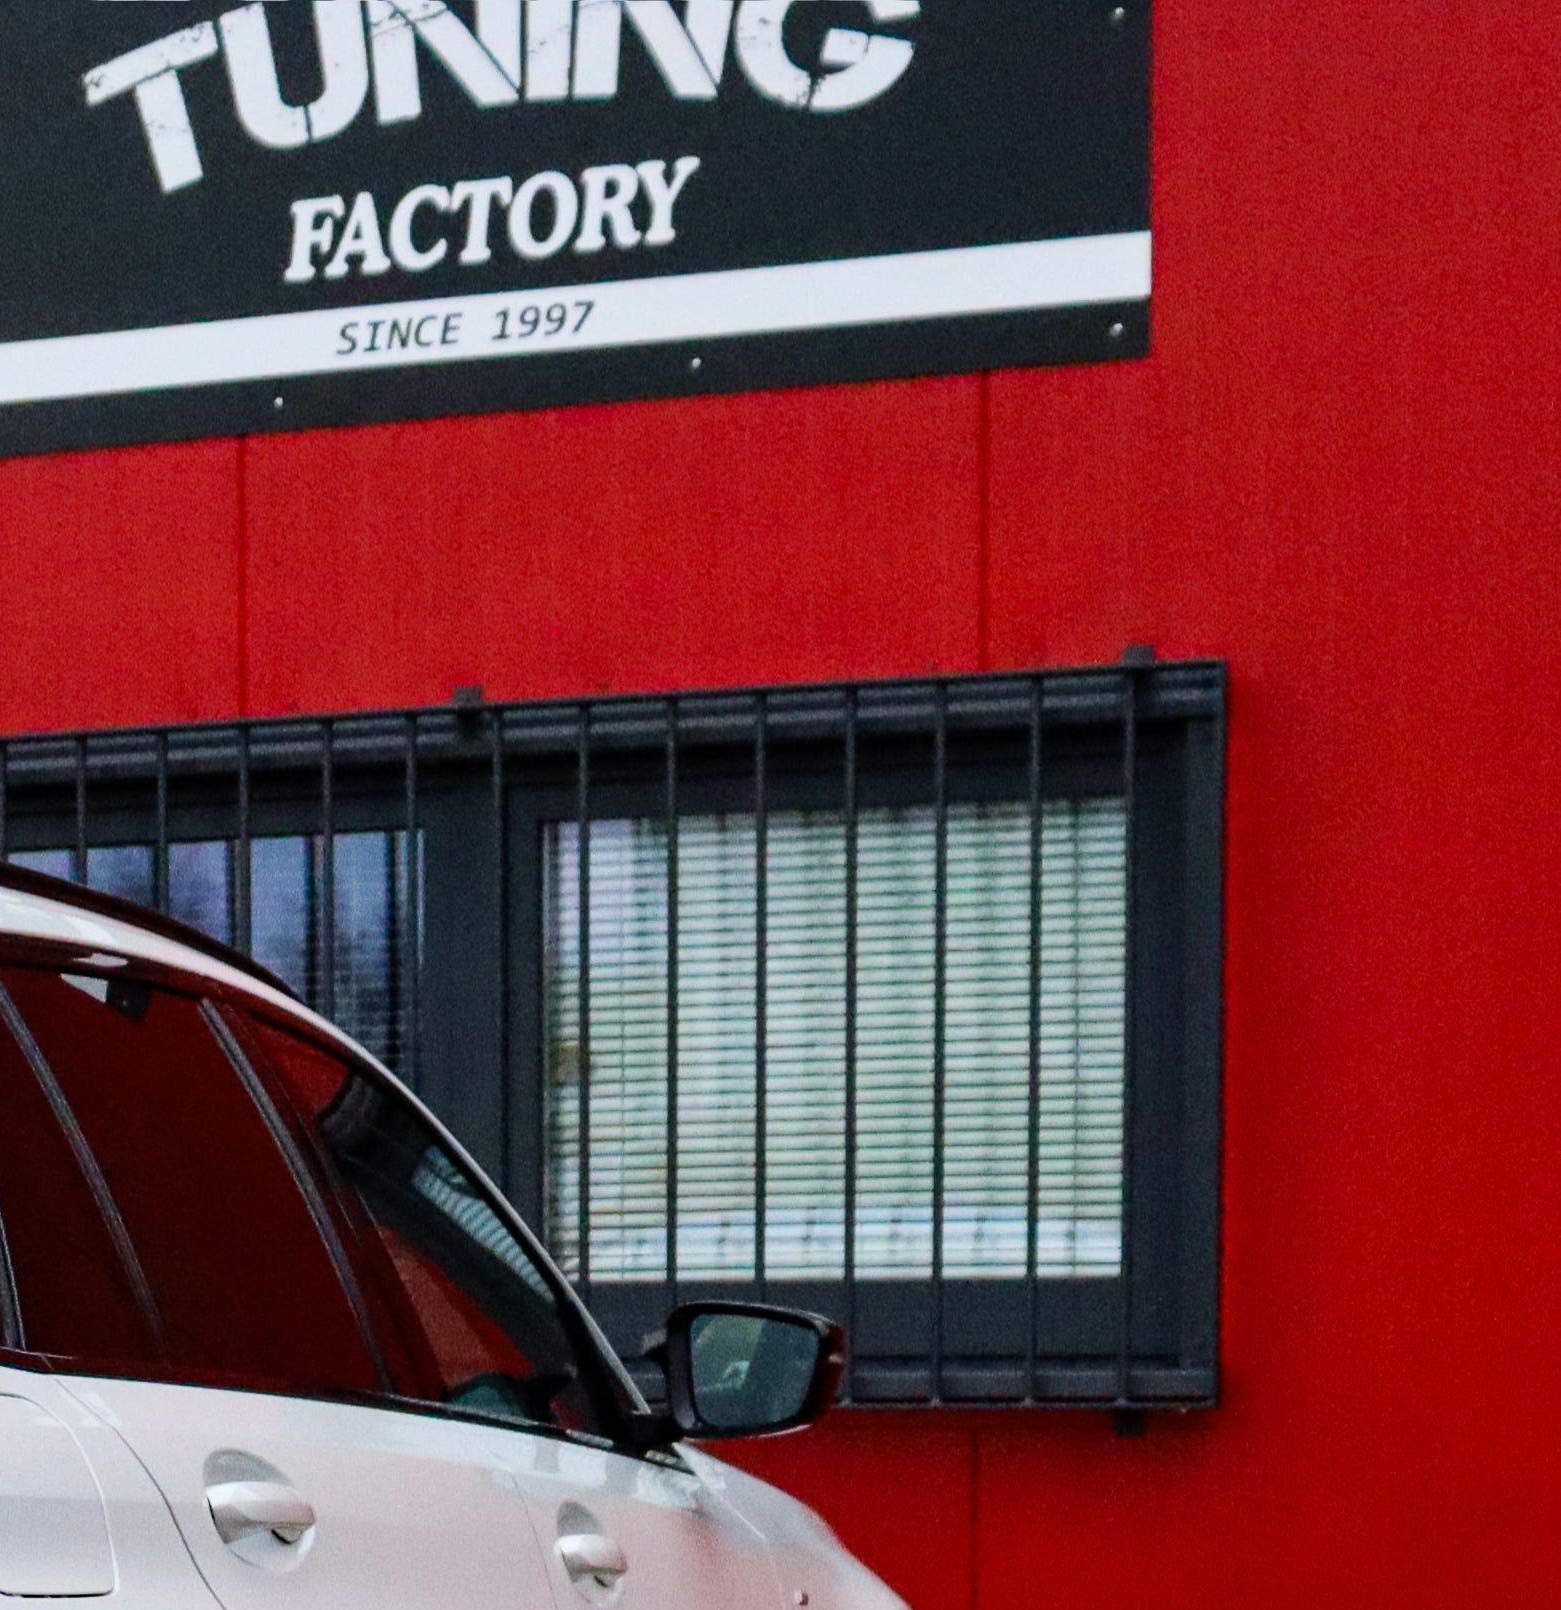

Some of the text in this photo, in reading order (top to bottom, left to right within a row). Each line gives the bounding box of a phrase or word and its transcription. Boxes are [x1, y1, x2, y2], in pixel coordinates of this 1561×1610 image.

[81, 0, 920, 193] TUNING
[284, 156, 700, 284] FACTORY
[336, 300, 596, 356] SINCE 1997
